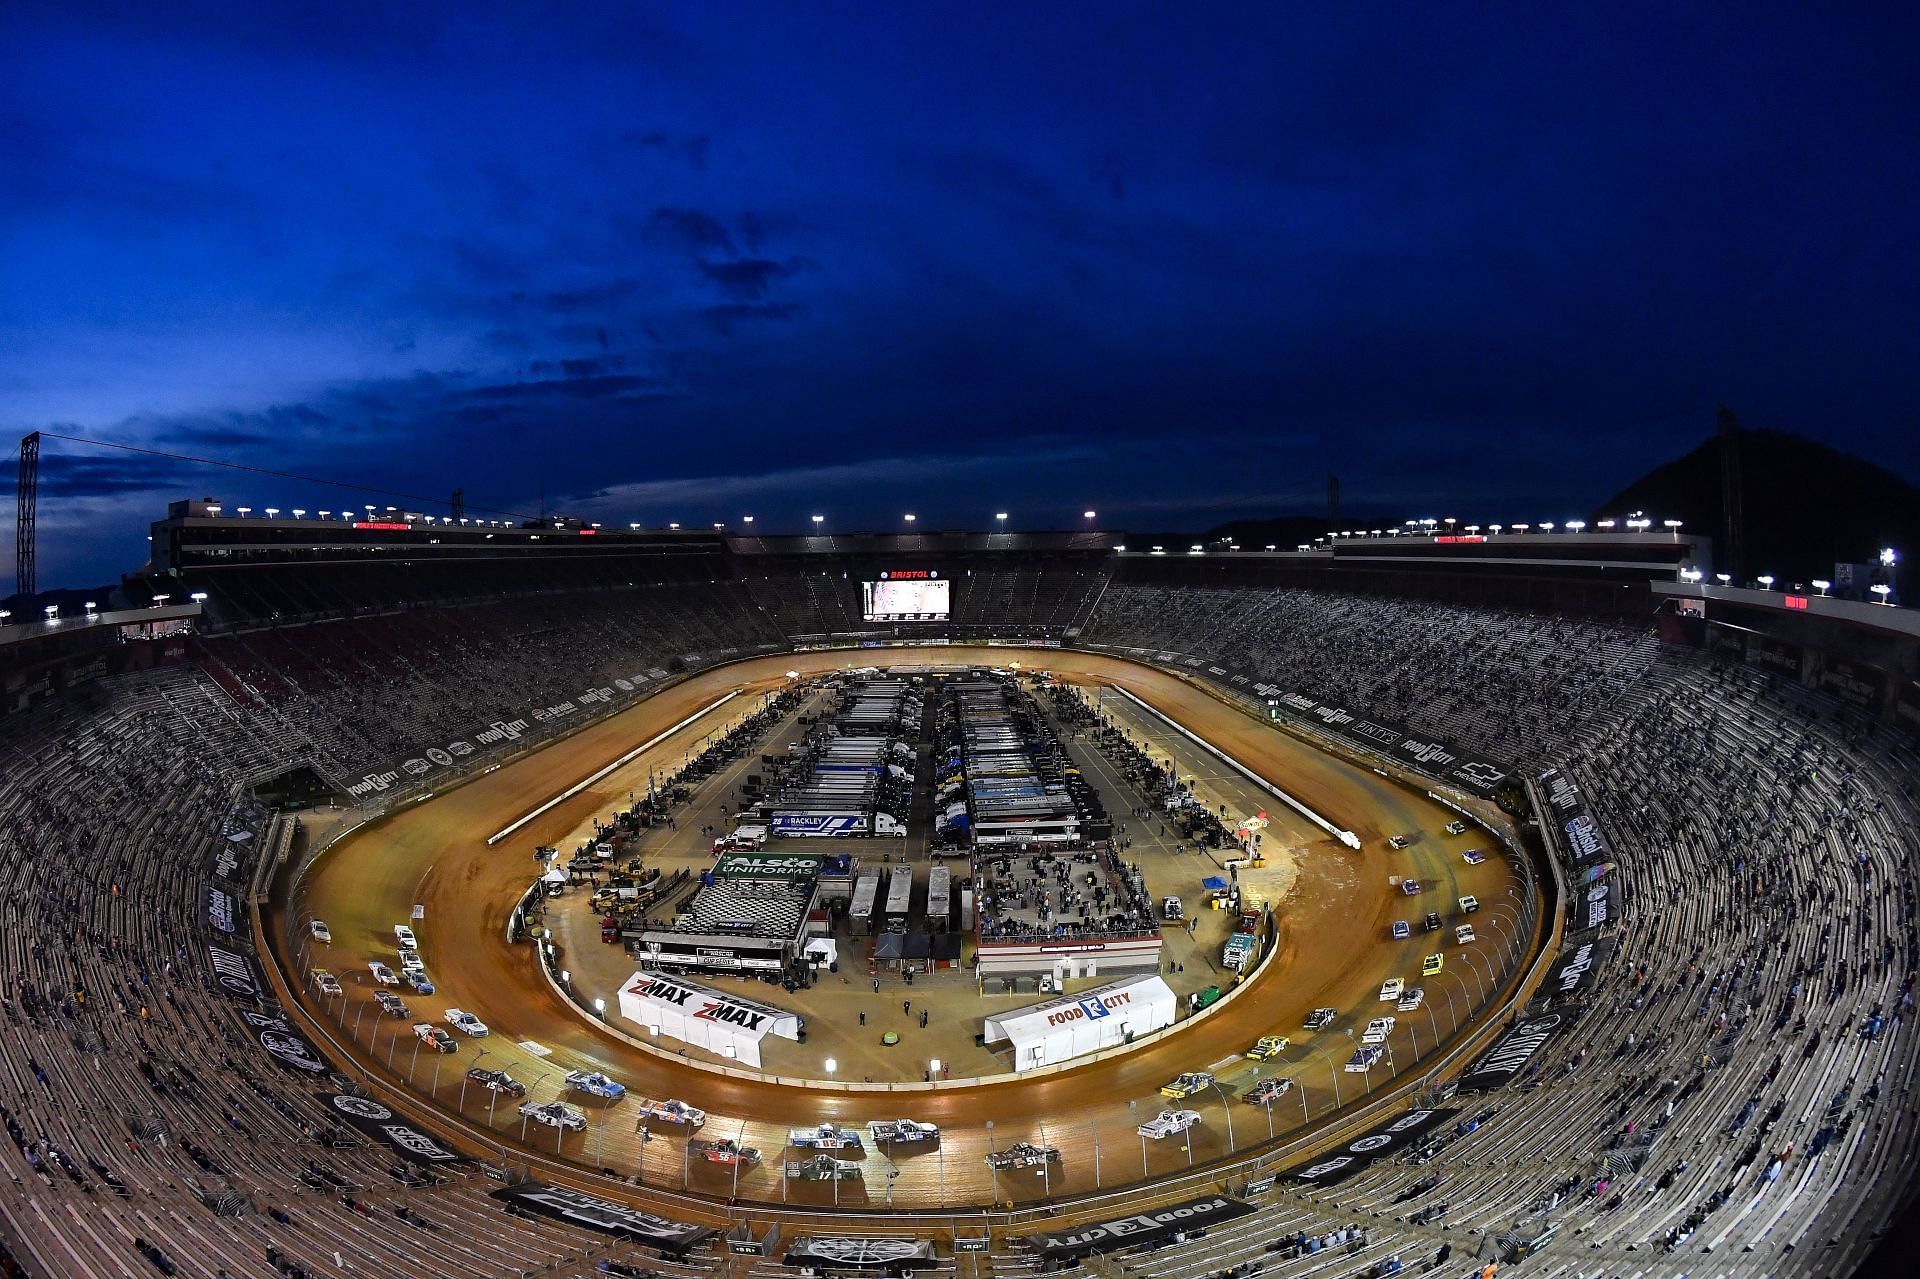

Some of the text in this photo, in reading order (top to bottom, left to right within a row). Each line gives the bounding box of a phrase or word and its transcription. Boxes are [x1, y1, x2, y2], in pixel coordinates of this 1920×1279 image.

[890, 571, 929, 579] BRISTOL
[475, 718, 530, 745] FOOD CITY
[1359, 721, 1398, 742] PINTY'S
[1400, 739, 1456, 765] FOOD CITY
[379, 770, 400, 784] CITY
[1453, 770, 1494, 790] CHEVROLET
[790, 817, 823, 825] RACKLEY
[1240, 820, 1269, 829] SUNOCO
[1575, 823, 1603, 856] Bristol
[726, 857, 818, 867] ALSCO
[722, 866, 813, 875] UNIFORMS
[208, 886, 226, 921] Bristol
[627, 979, 693, 1007] ZMAX
[692, 1002, 768, 1032] ZMAX
[1047, 1007, 1085, 1028] FOOD
[1102, 992, 1132, 1010] CITY
[486, 1080, 497, 1090] 15
[903, 1132, 916, 1141] 16
[718, 1152, 730, 1162] 56
[1025, 1156, 1037, 1166] 51
[818, 1171, 832, 1180] 17
[1046, 1199, 1229, 1249] FOOD CITY
